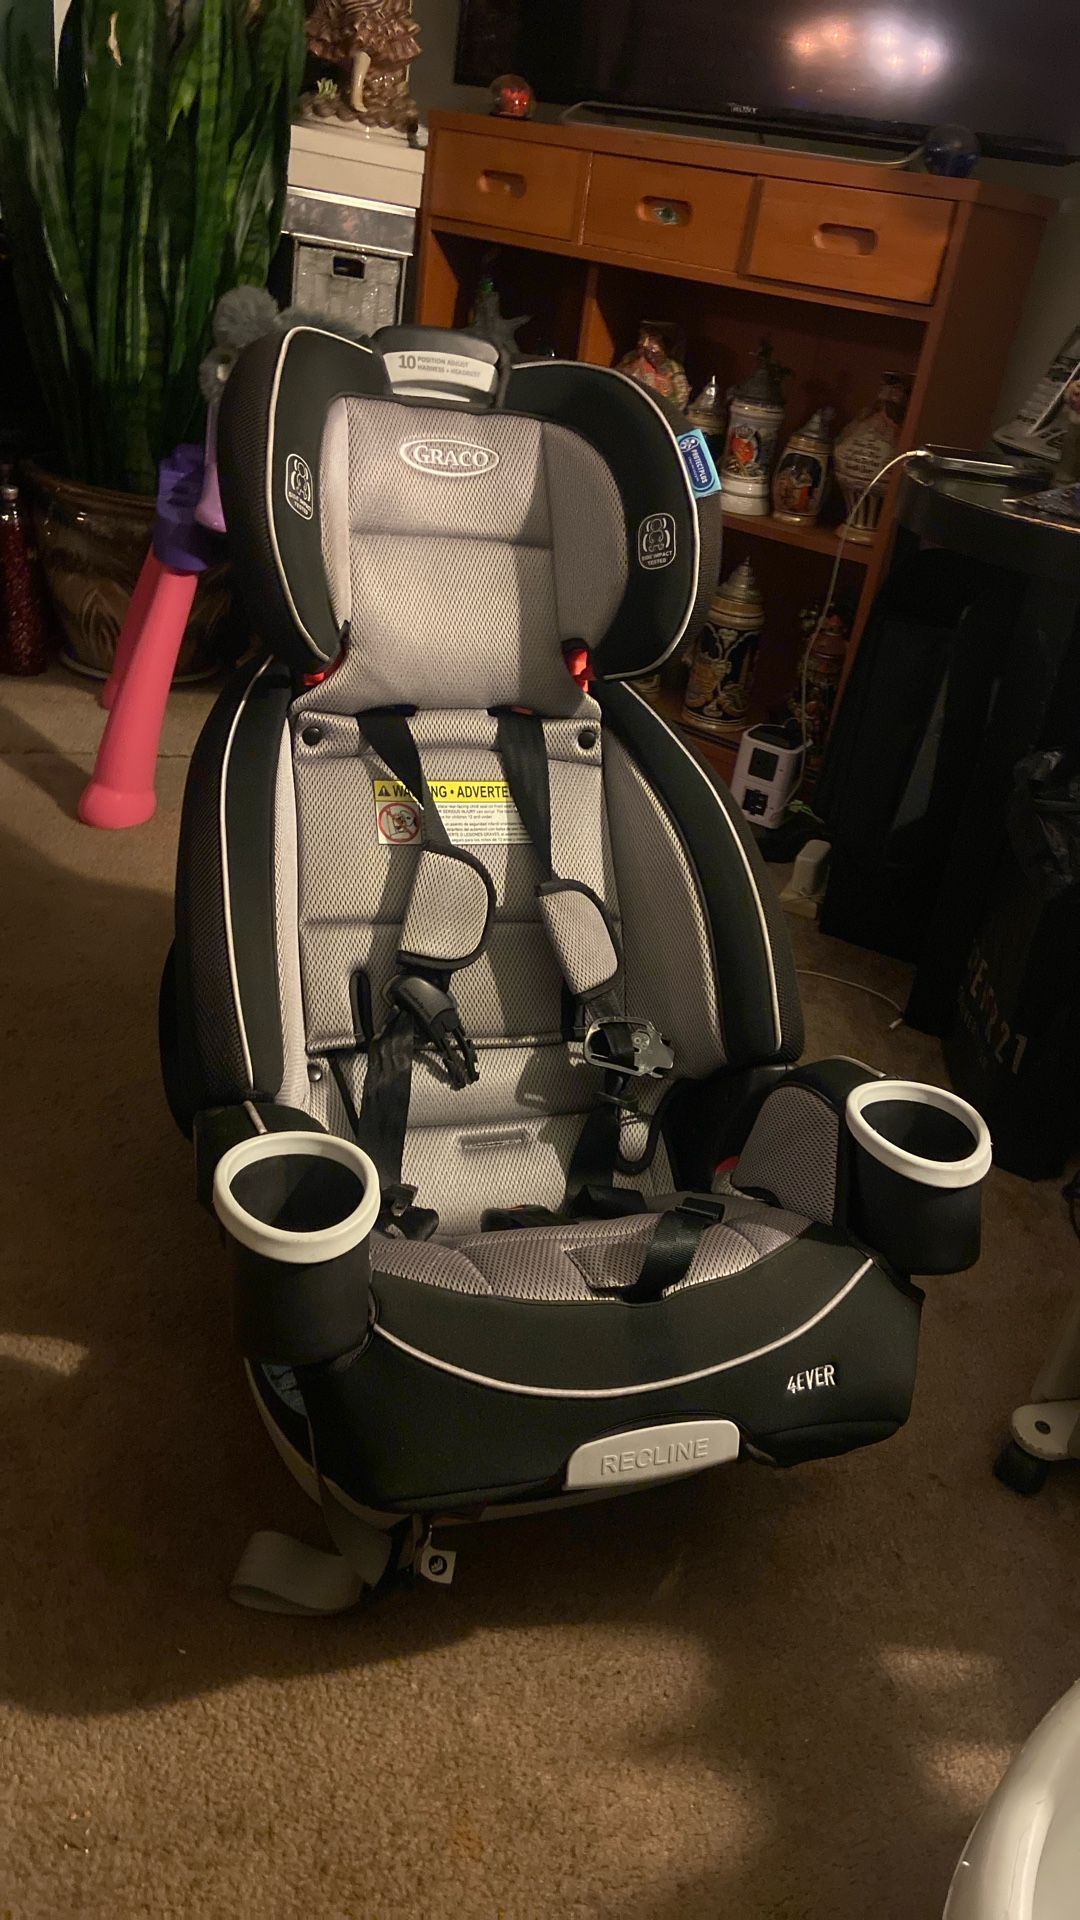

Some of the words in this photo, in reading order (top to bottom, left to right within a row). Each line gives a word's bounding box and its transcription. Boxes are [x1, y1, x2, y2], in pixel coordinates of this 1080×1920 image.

[398, 355, 416, 369] 10
[417, 356, 445, 365] POSITION
[418, 364, 445, 373] HARNESS
[413, 445, 489, 467] GRACO
[653, 550, 672, 559] IMPACT
[647, 557, 667, 566] TESTED
[457, 785, 511, 798] ADVERTE
[786, 1364, 836, 1395] 4EVER
[601, 1438, 710, 1476] RECLINE
